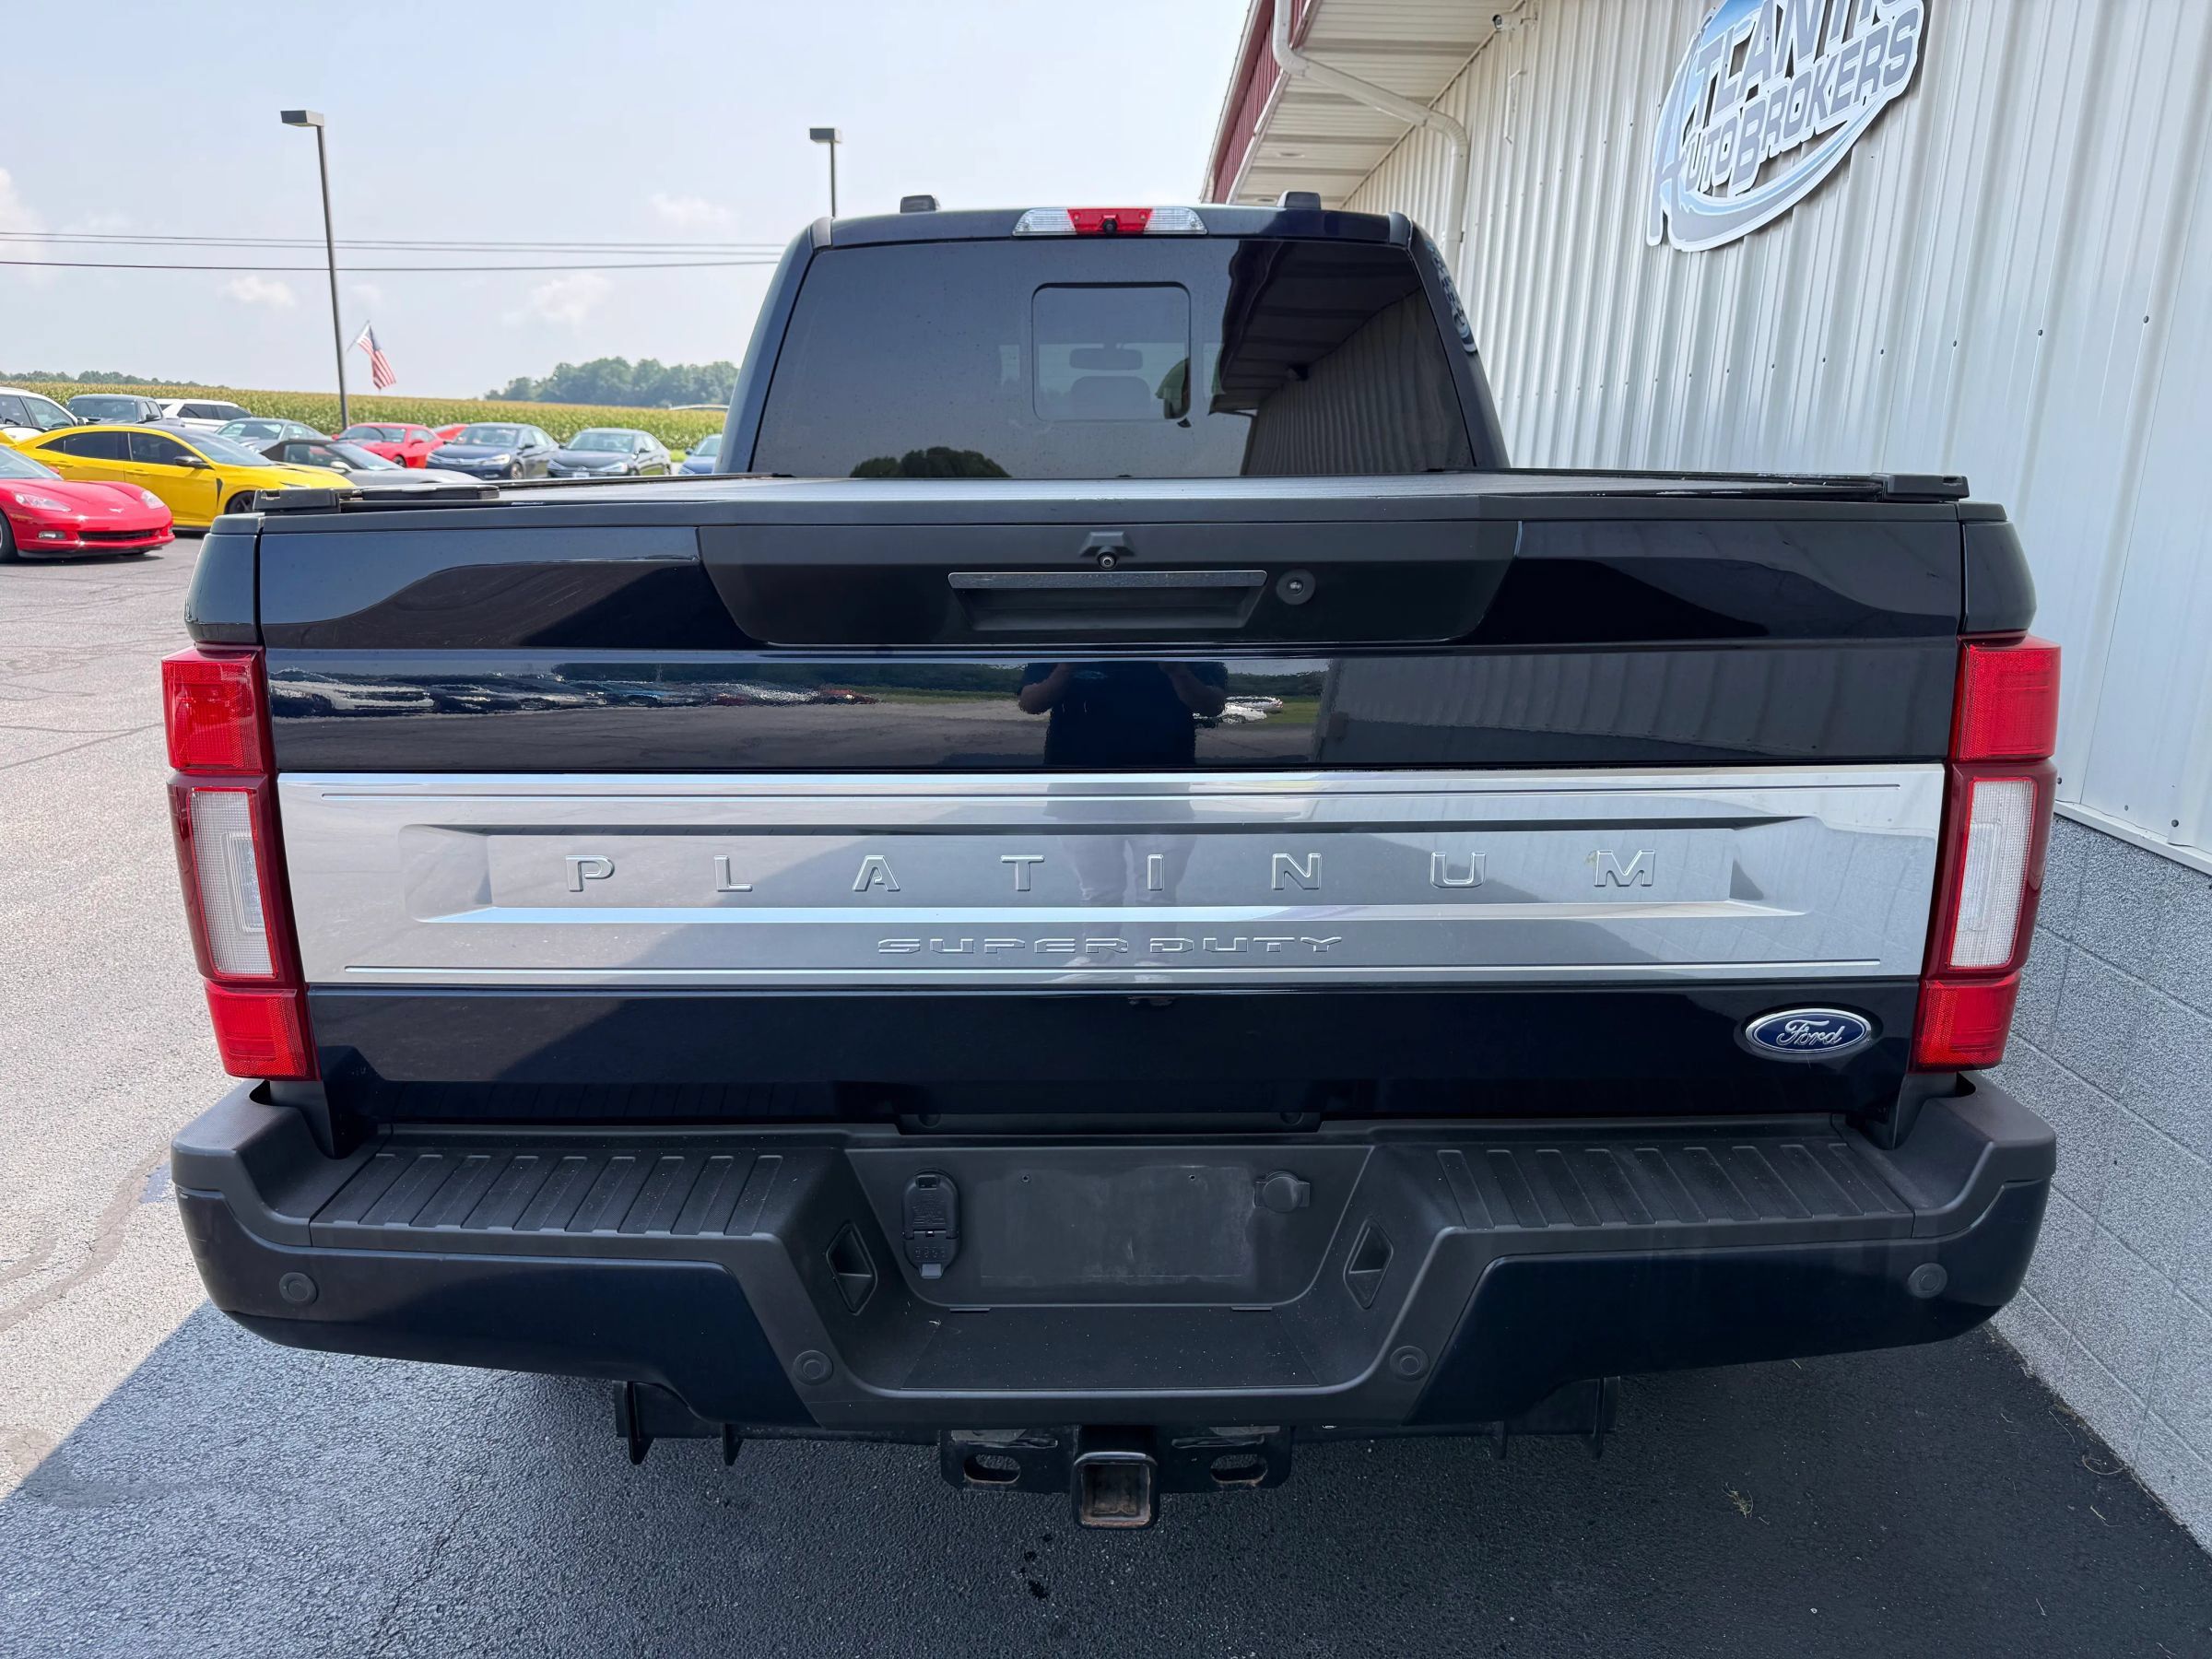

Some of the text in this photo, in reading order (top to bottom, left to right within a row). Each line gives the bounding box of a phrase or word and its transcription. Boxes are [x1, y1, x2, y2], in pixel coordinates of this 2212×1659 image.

[565, 849, 1657, 893] PLATINUM
[877, 935, 1343, 955] SUPER DUTY
[1775, 1019, 1846, 1046] Ford
